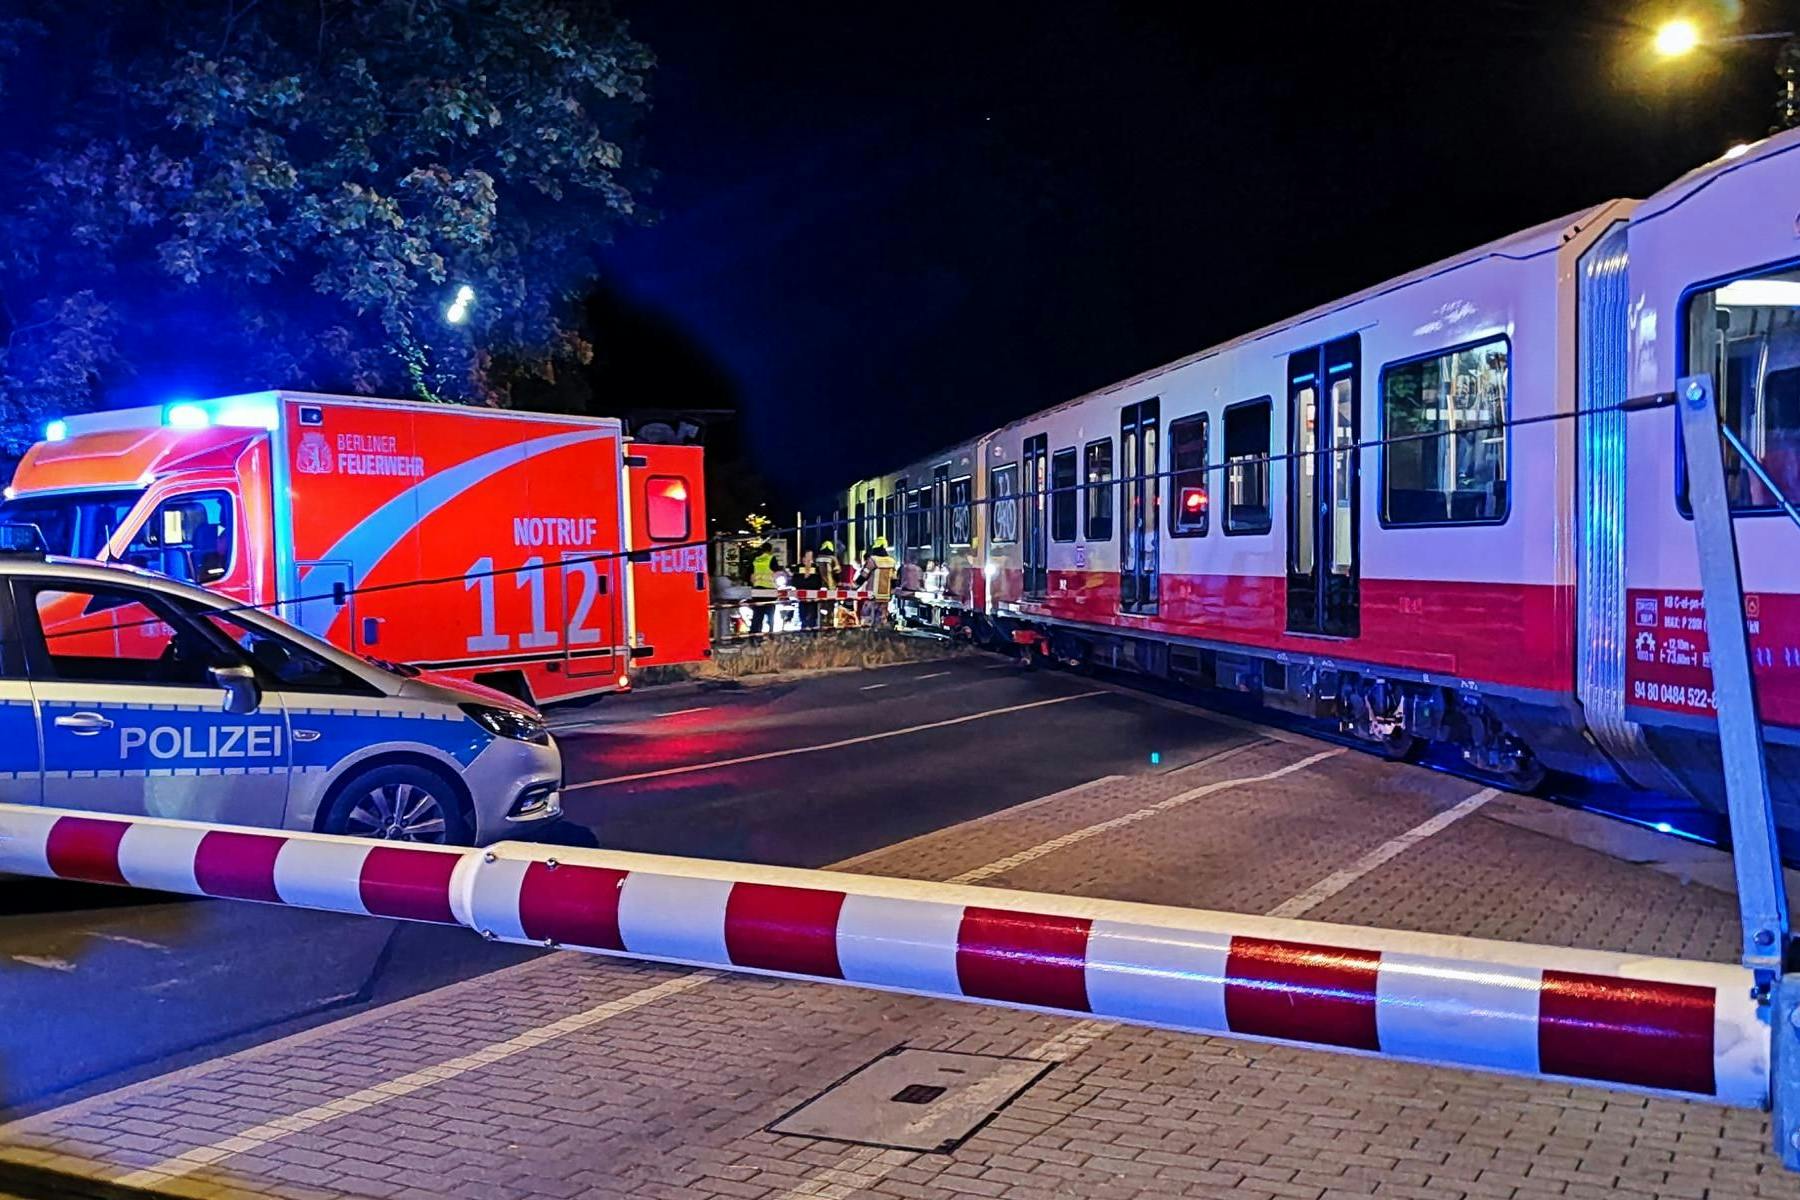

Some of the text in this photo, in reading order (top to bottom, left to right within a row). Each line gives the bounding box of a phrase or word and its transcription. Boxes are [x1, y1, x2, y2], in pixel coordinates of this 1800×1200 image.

[337, 433, 397, 453] BERLINER
[337, 453, 425, 477] FEUERWEHR
[513, 516, 597, 547] NOTRUF
[464, 555, 602, 653] 112
[1634, 680, 1646, 699] 94
[1647, 682, 1659, 701] 80
[1660, 683, 1686, 705] 0484
[119, 724, 283, 760] POLIZEI
